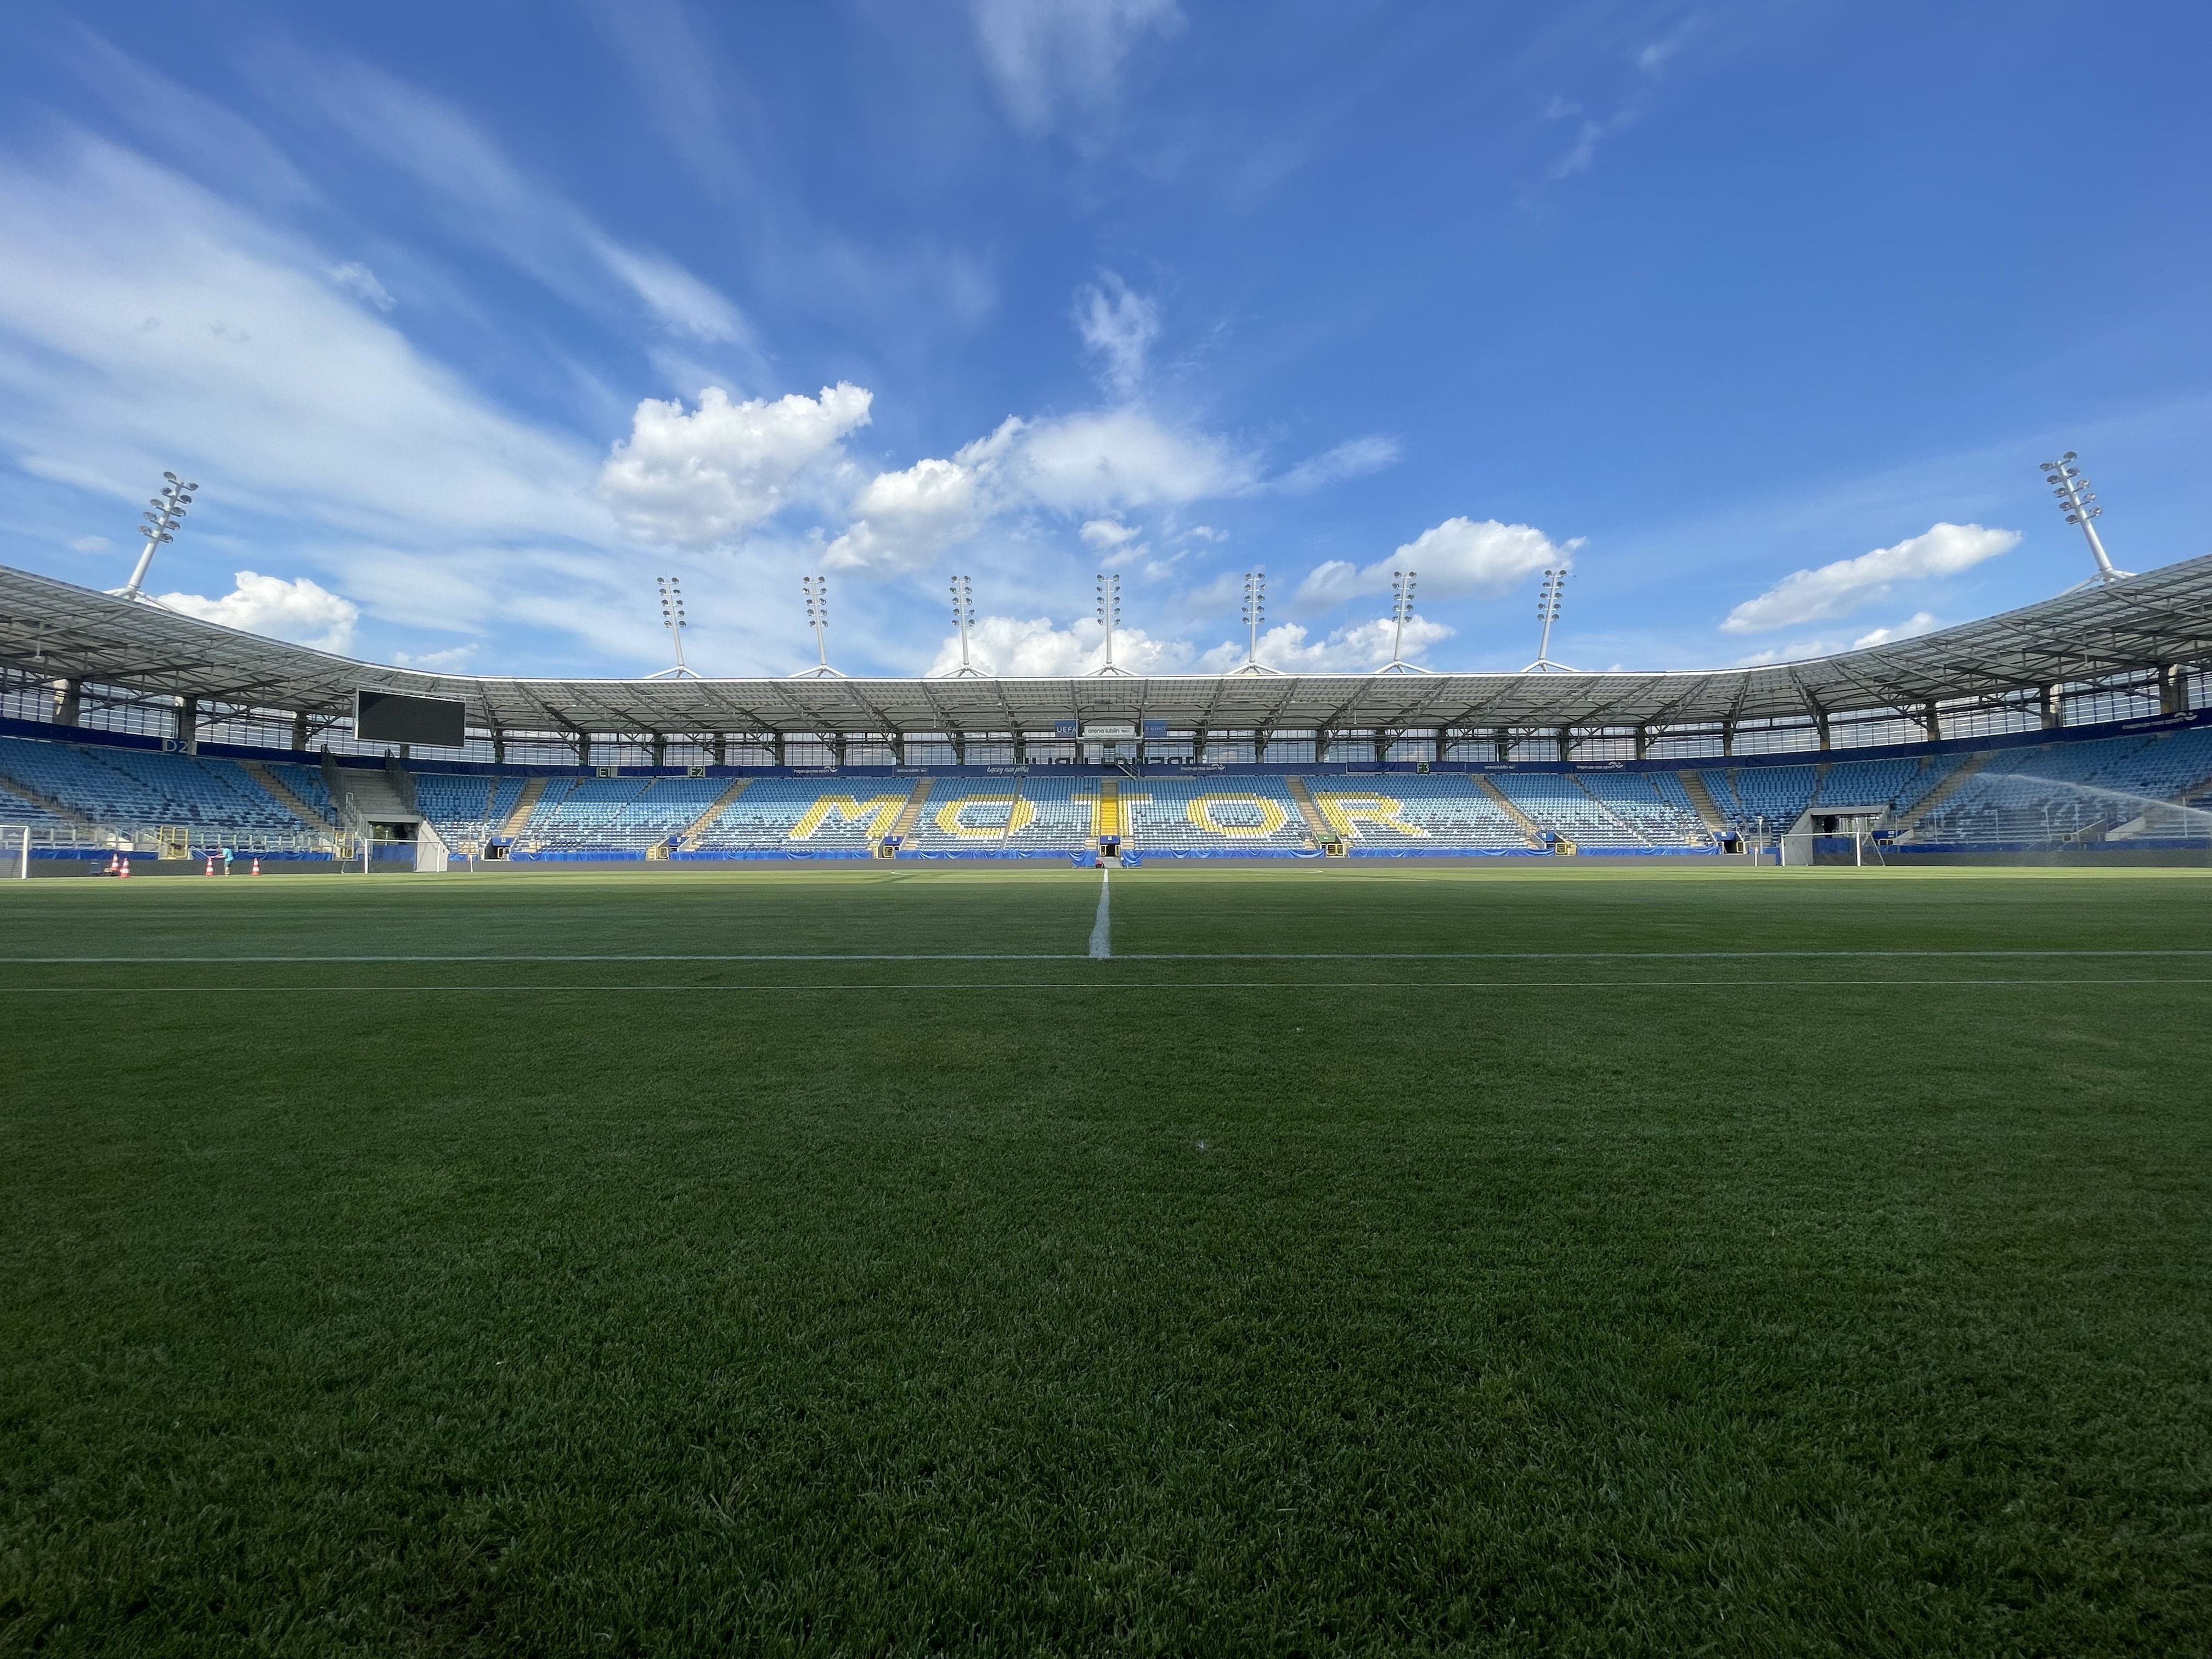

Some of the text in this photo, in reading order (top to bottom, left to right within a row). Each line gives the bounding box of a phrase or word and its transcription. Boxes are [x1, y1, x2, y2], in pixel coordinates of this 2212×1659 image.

[165, 739, 188, 753] D2
[1417, 763, 1429, 772] F3
[599, 768, 610, 777] E1
[690, 768, 703, 777] E2
